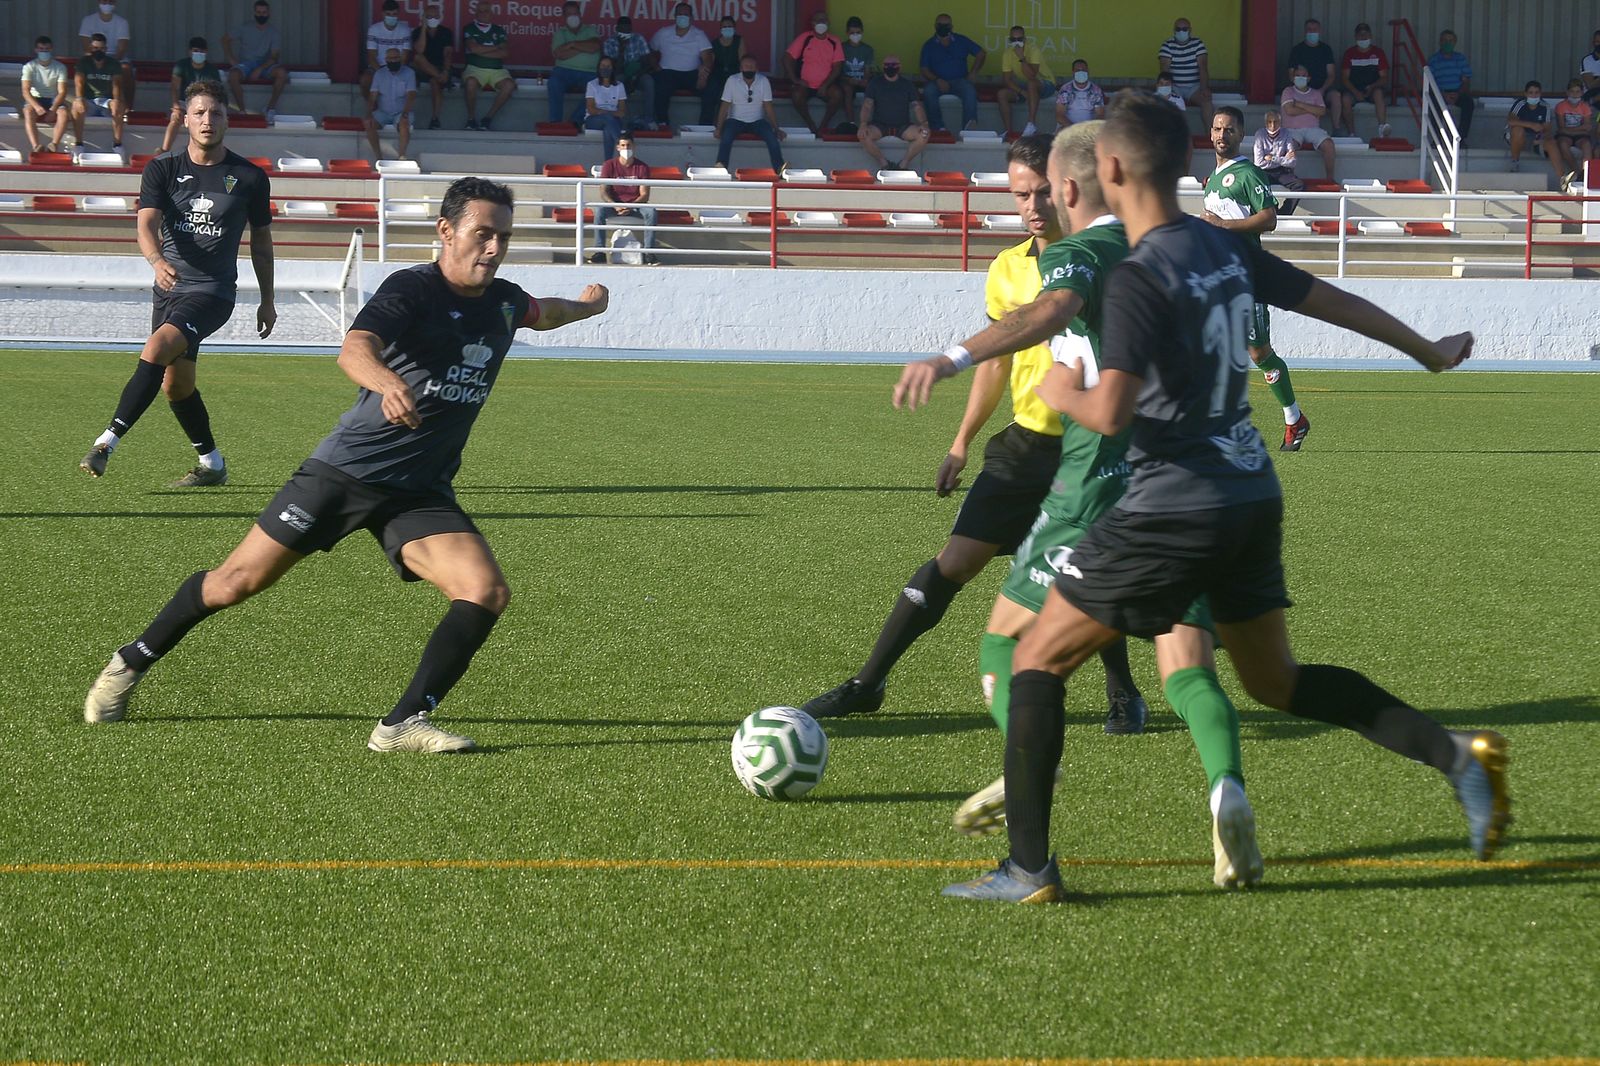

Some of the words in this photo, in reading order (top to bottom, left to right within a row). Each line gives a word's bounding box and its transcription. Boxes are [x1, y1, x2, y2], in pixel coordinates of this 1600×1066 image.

[468, 0, 501, 16] Sn
[507, 1, 563, 20] Roque
[184, 212, 214, 225] REAL
[174, 221, 222, 237] HOOKAH
[1202, 293, 1254, 417] 10
[446, 365, 488, 386] REAL
[423, 379, 488, 404] HOOKAH
